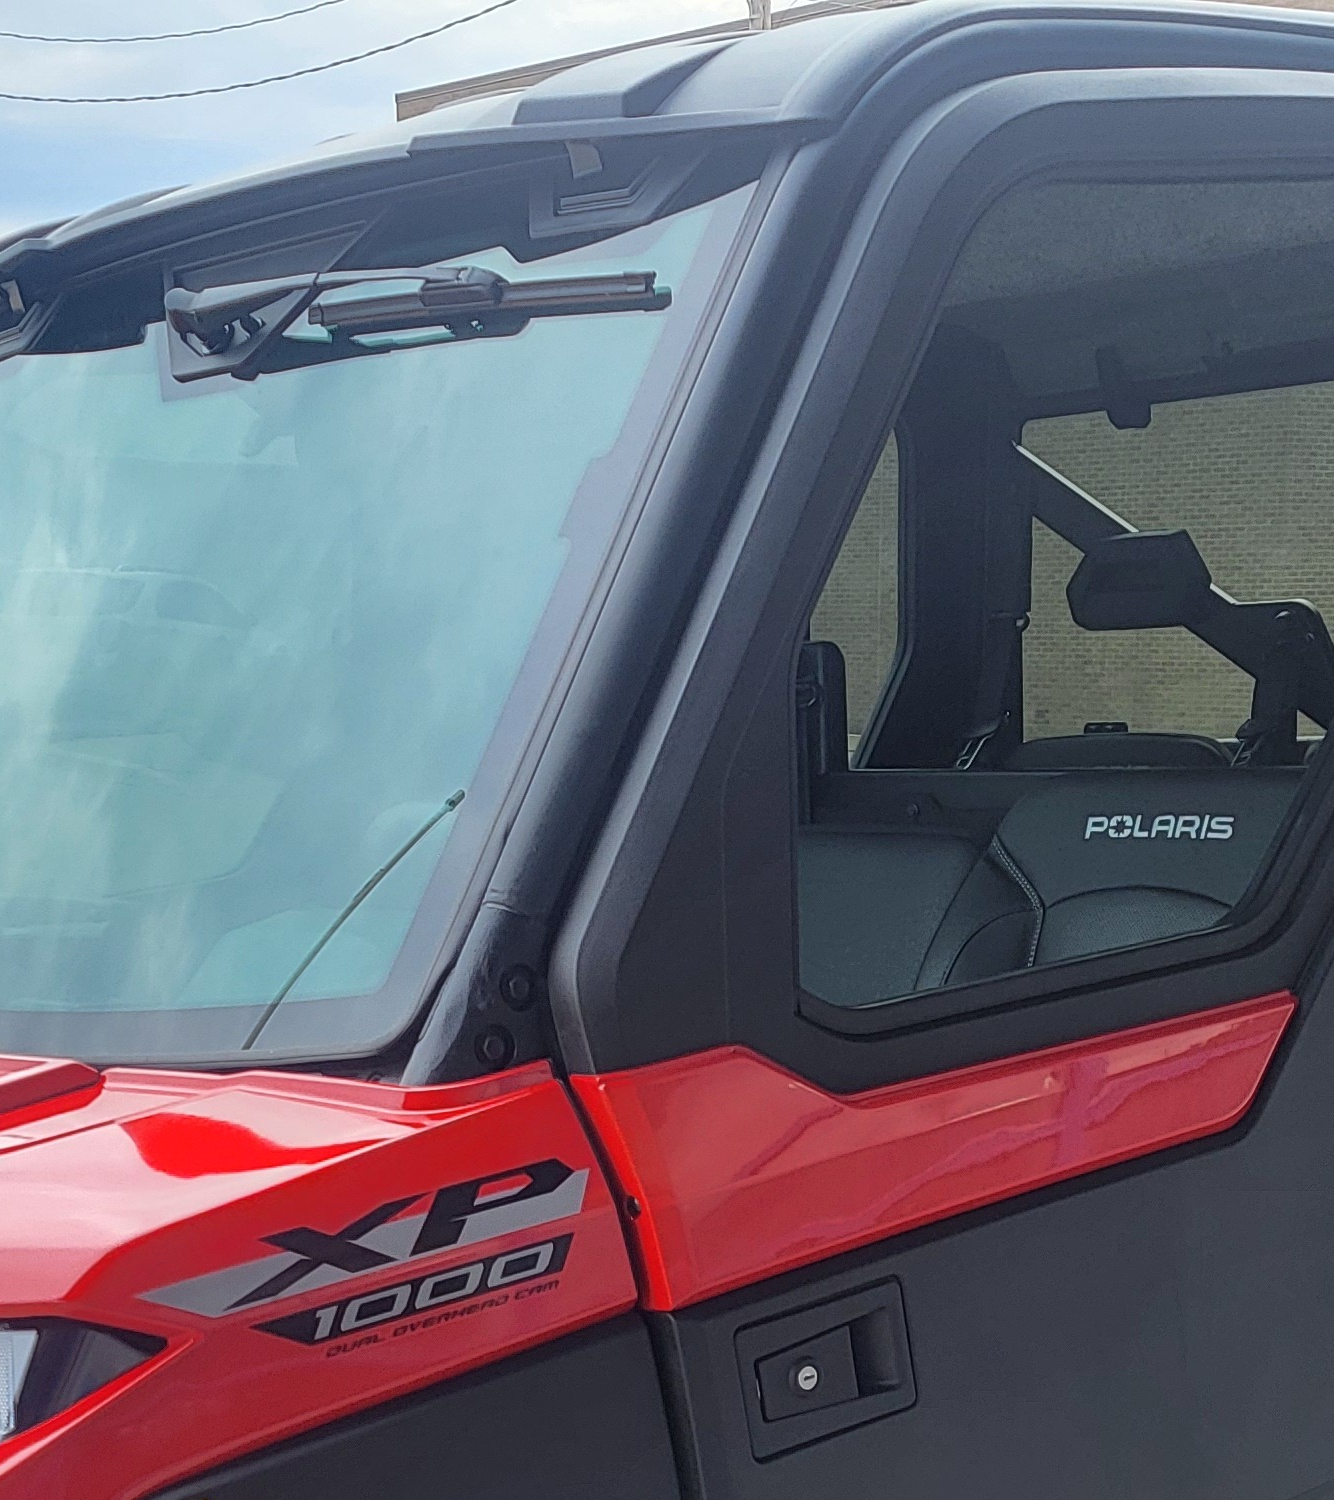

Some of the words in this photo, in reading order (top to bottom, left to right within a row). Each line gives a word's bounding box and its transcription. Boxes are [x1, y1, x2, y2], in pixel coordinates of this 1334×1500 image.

[1084, 814, 1234, 840] POLARIS
[224, 1158, 575, 1310] XP
[314, 1241, 556, 1341] 1000
[326, 1334, 385, 1358] DUAL
[393, 1294, 509, 1338] OVERHEAD
[514, 1279, 560, 1301] CAM
